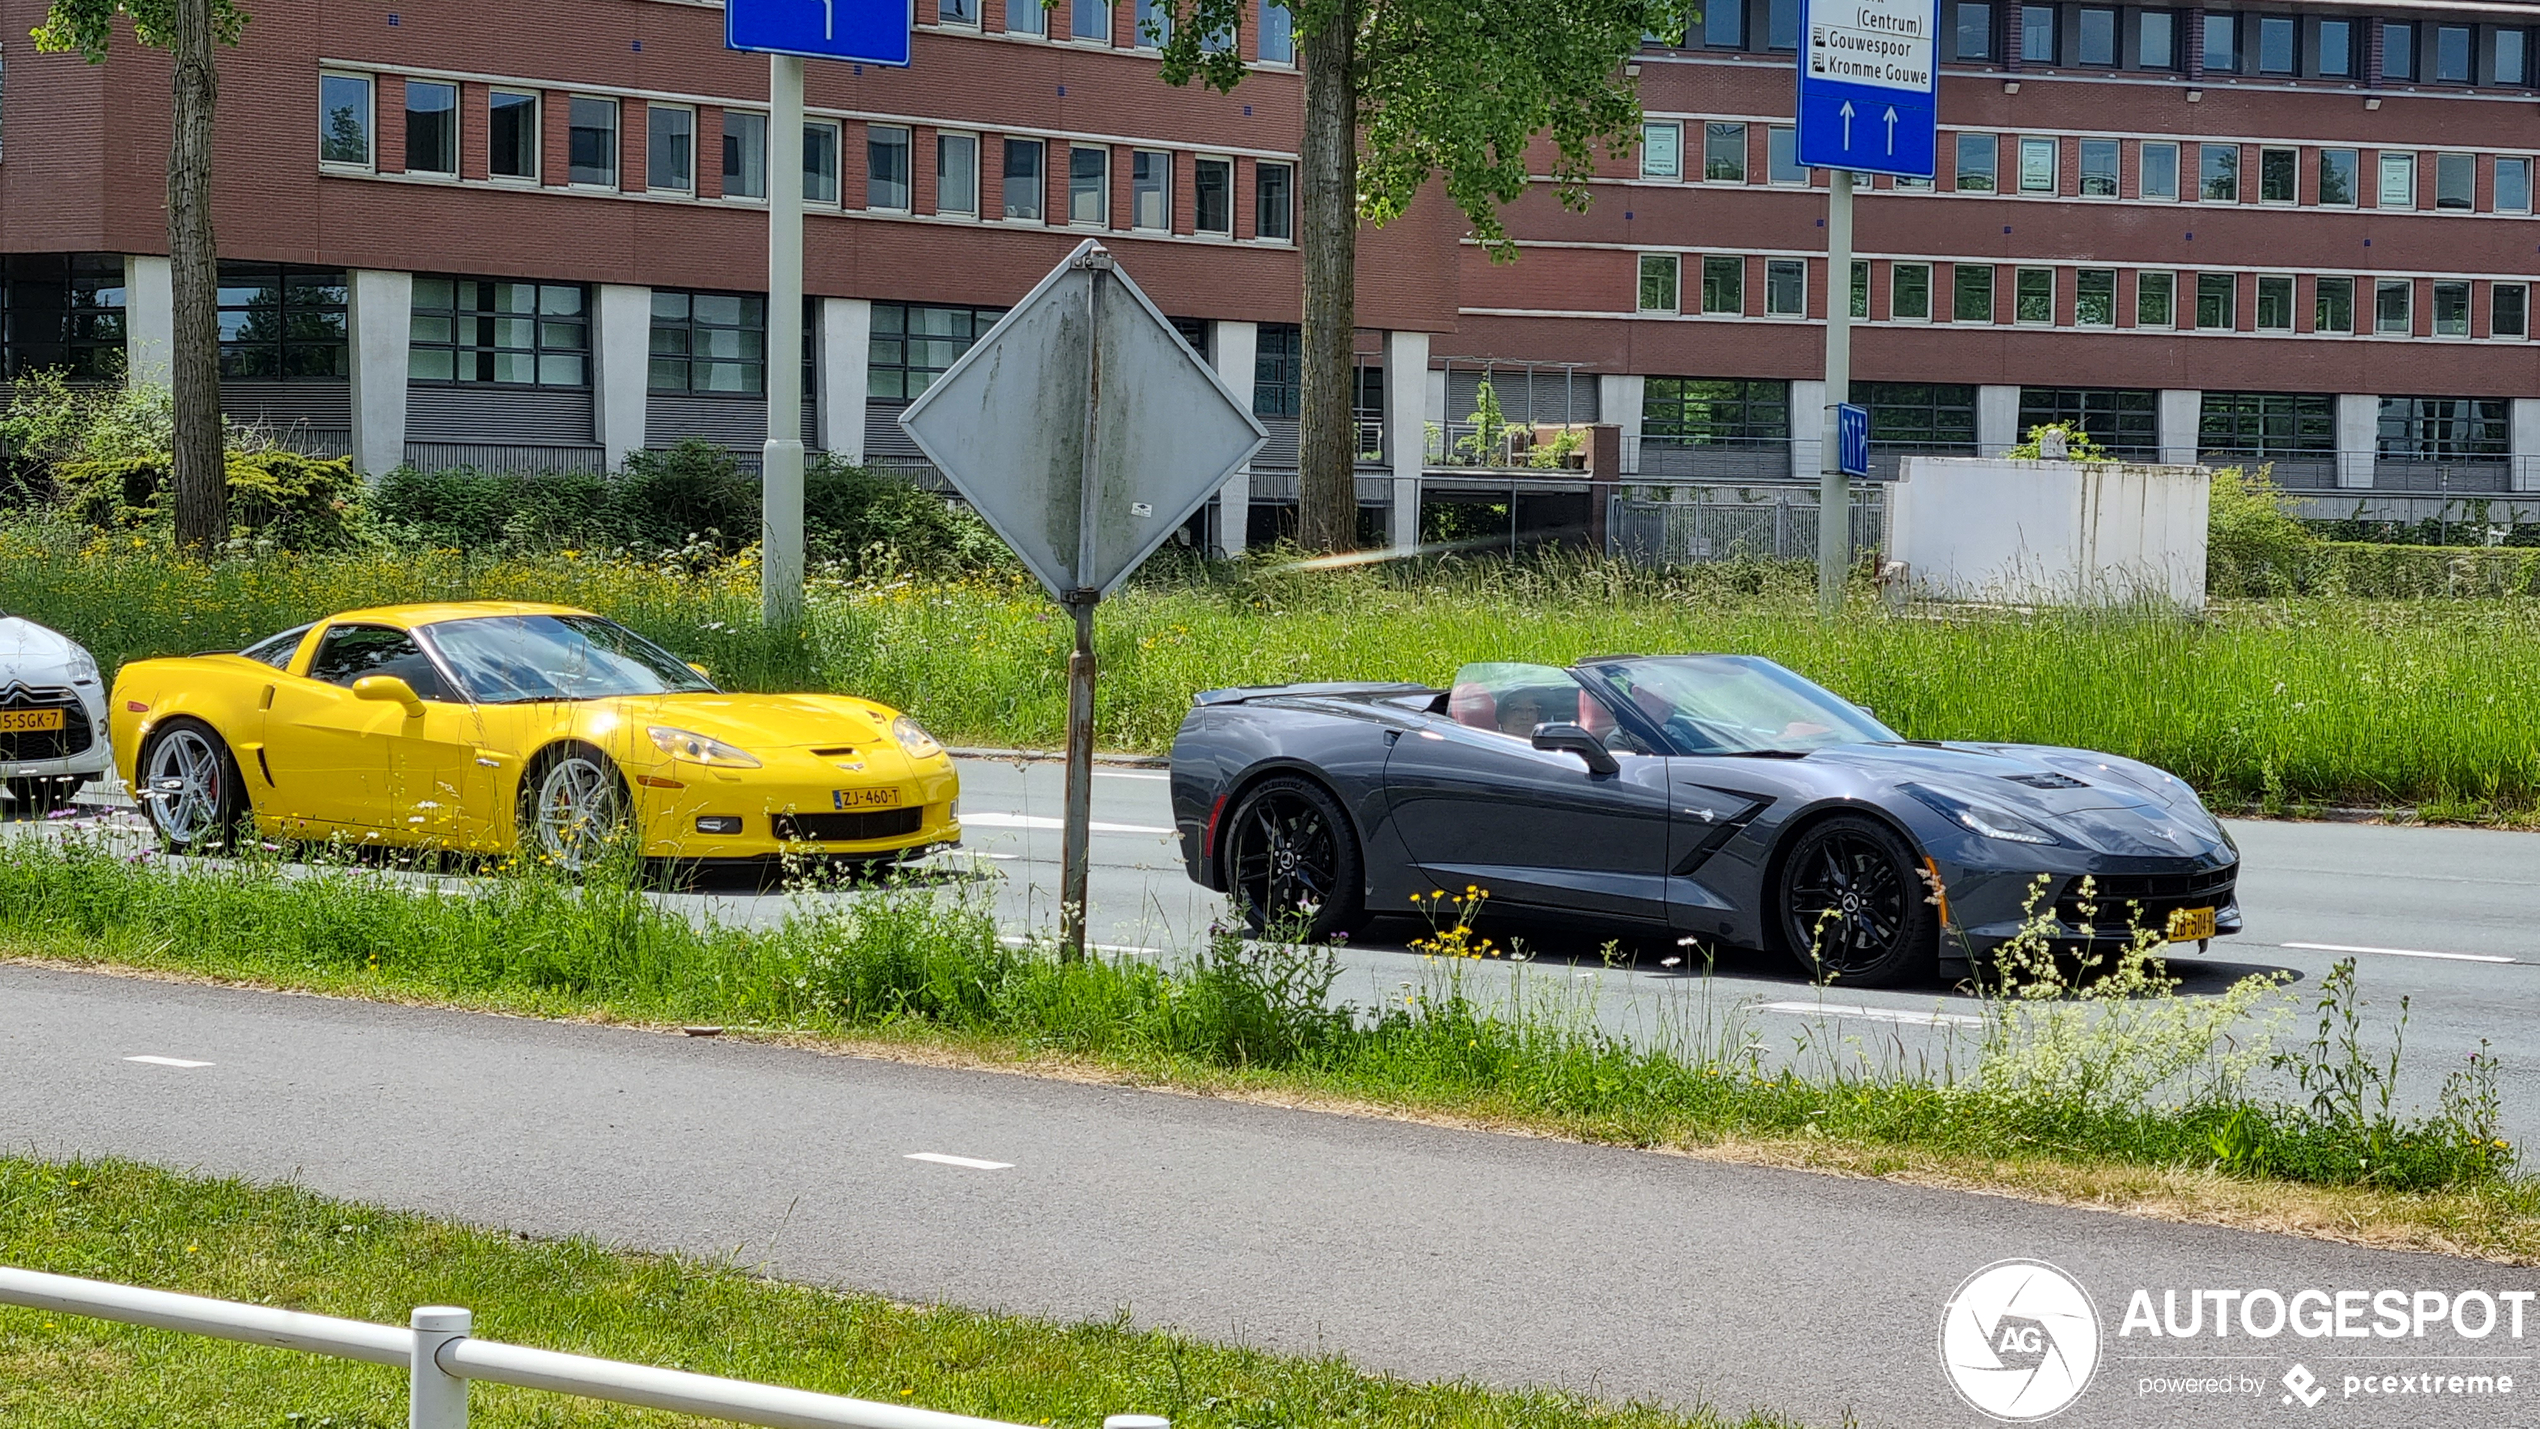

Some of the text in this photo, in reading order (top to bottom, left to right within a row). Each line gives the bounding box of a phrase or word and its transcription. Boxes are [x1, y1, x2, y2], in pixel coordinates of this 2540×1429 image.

[1857, 6, 1922, 36] (Centrum)
[1830, 31, 1911, 58] Gouwespoor
[1829, 55, 1927, 85] Kromme Gouwe
[0, 711, 58, 729] 5-SGK-7
[842, 789, 898, 806] ZJ-460-T
